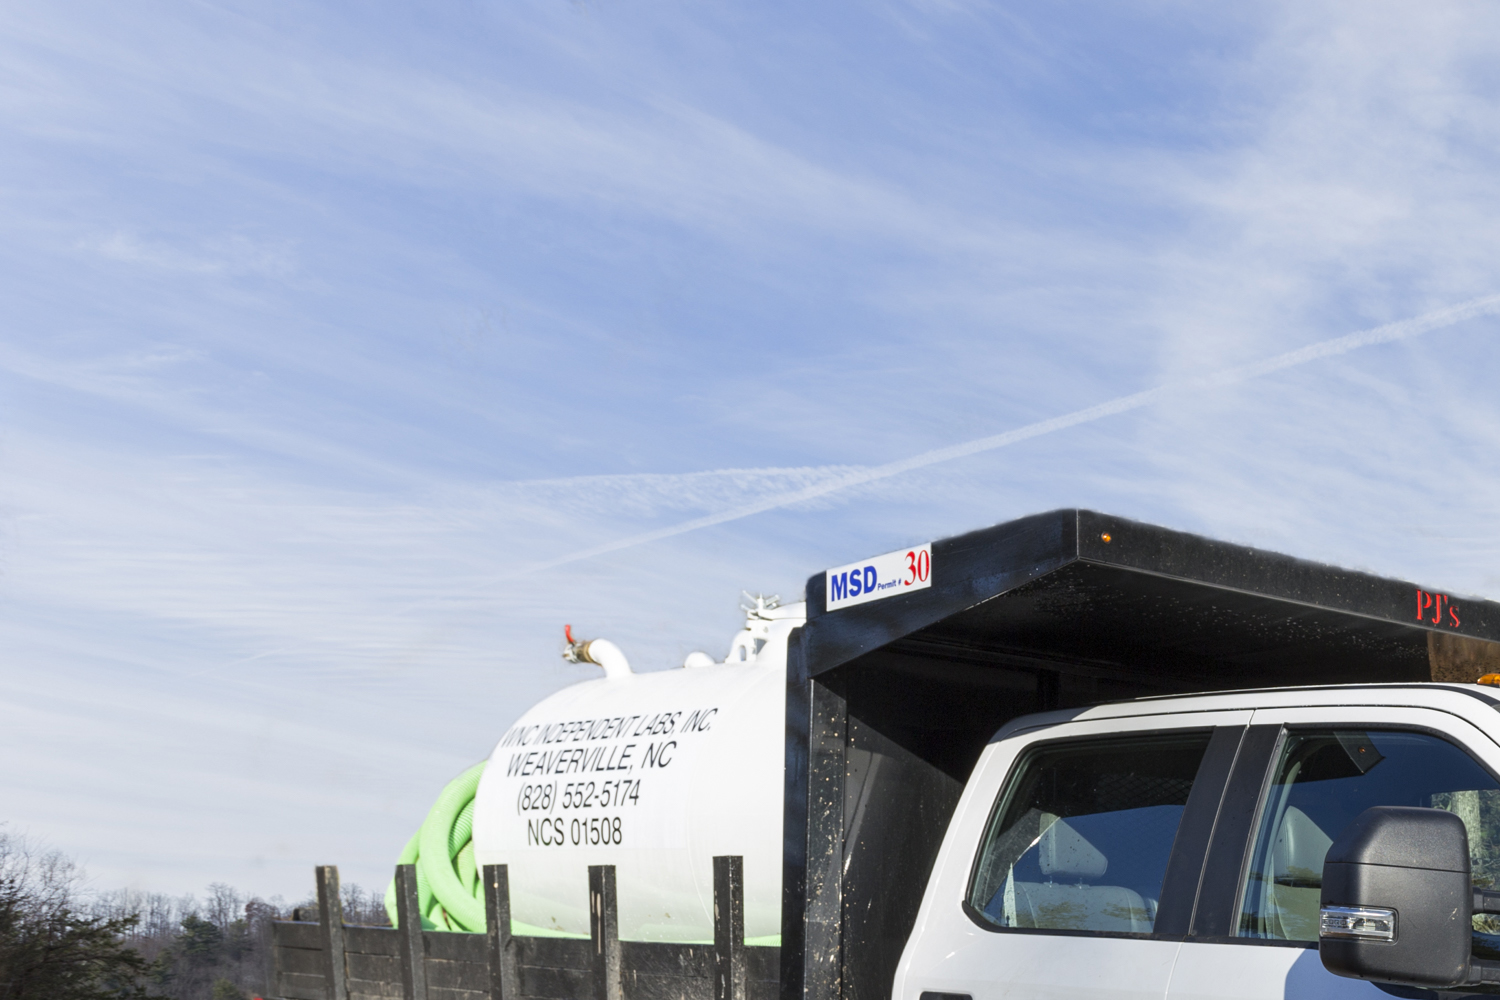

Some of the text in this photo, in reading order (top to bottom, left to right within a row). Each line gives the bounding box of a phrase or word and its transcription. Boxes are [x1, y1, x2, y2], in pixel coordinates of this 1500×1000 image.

[831, 565, 878, 602] MSD
[877, 579, 897, 591] Permit
[904, 549, 930, 586] 30
[1415, 589, 1461, 628] PJ's
[501, 708, 718, 748] WNC INDEPENDENT LABS, INC.
[506, 740, 677, 777] WEAVERVILLE, NC
[517, 779, 641, 815] (828) 552-5174
[527, 816, 623, 846] NCS 01508
